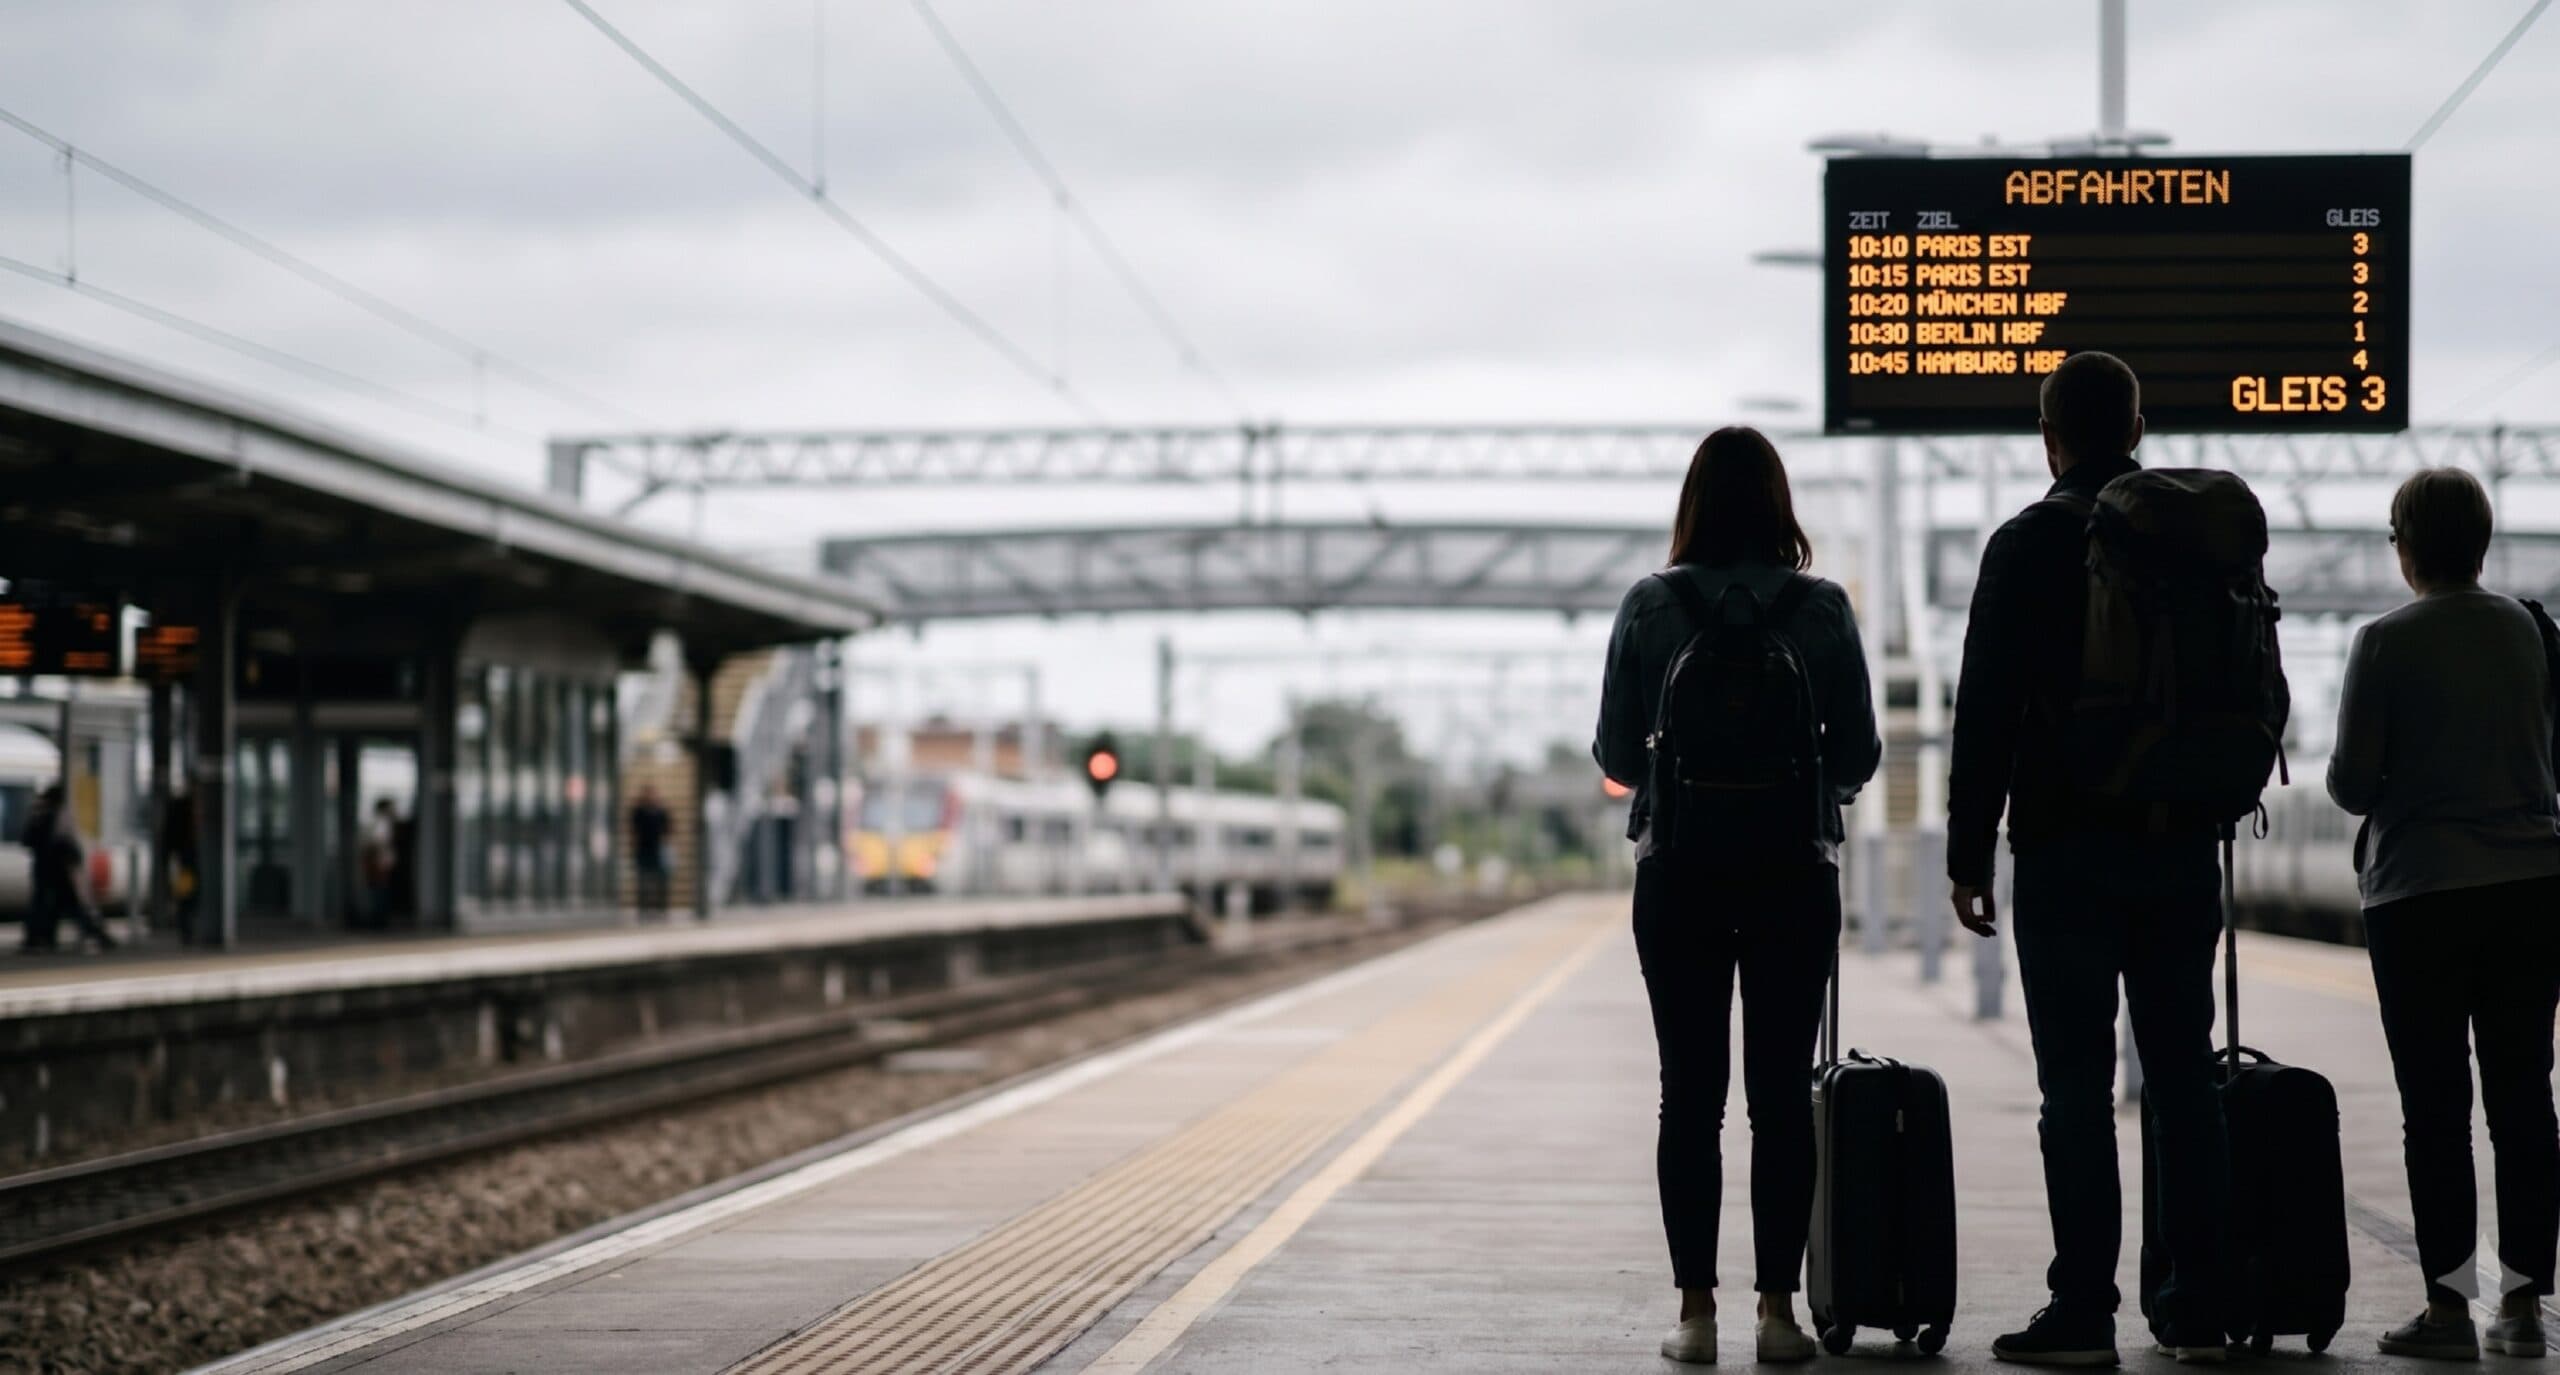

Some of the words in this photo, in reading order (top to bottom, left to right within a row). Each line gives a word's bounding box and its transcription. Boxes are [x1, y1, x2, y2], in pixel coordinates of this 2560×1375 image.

[2006, 170, 2229, 204] ABFAHRTEN
[1849, 212, 1889, 229] ZEIT
[1917, 211, 1958, 229] ZIEL
[2327, 209, 2379, 226] GLEIS
[1849, 235, 1908, 258] 10:10
[1916, 235, 1981, 257] PARIS
[1989, 235, 2031, 257] EST
[2354, 233, 2368, 255] 3
[1849, 264, 1908, 287] 10:15
[1916, 264, 1982, 286] PARIS
[1989, 264, 2031, 286] EST
[2353, 262, 2368, 284] 3
[1849, 293, 1909, 316] 10:20
[1917, 289, 2017, 315] MÜNCHEN
[2025, 293, 2067, 314] HBF
[2353, 291, 2368, 313] 2
[1850, 323, 1909, 344] 10:30
[1916, 323, 1996, 344] BERLIN
[2003, 322, 2044, 344] HBF
[2355, 321, 2365, 341] 1
[1850, 352, 1909, 374] 10:45
[1917, 351, 2017, 374] HAMBURG
[2024, 351, 2066, 373] HBF
[2353, 350, 2368, 370] 4
[2233, 376, 2346, 411] GLEIS
[2362, 376, 2385, 411] 3
